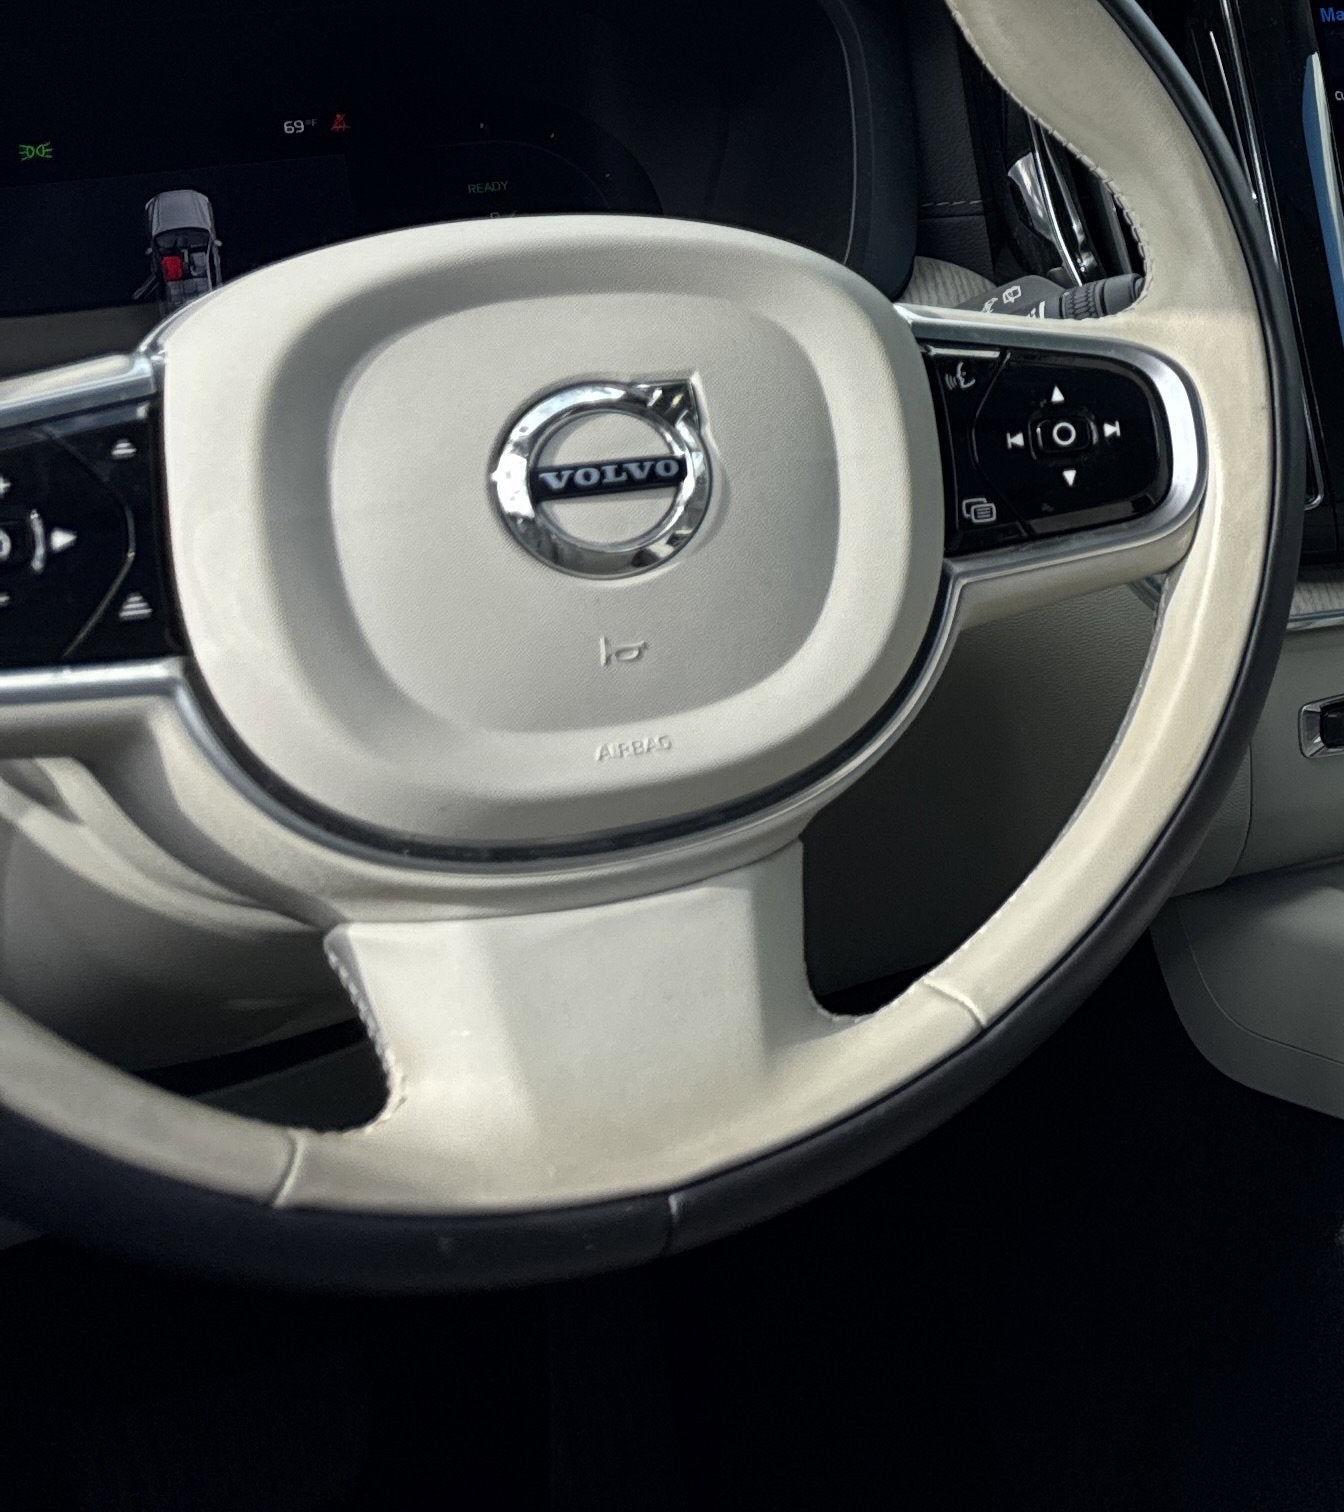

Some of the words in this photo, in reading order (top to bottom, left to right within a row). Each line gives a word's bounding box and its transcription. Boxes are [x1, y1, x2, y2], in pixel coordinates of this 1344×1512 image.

[467, 180, 509, 194] READY
[538, 459, 680, 490] VOLVO
[594, 734, 673, 763] AIRBAG
